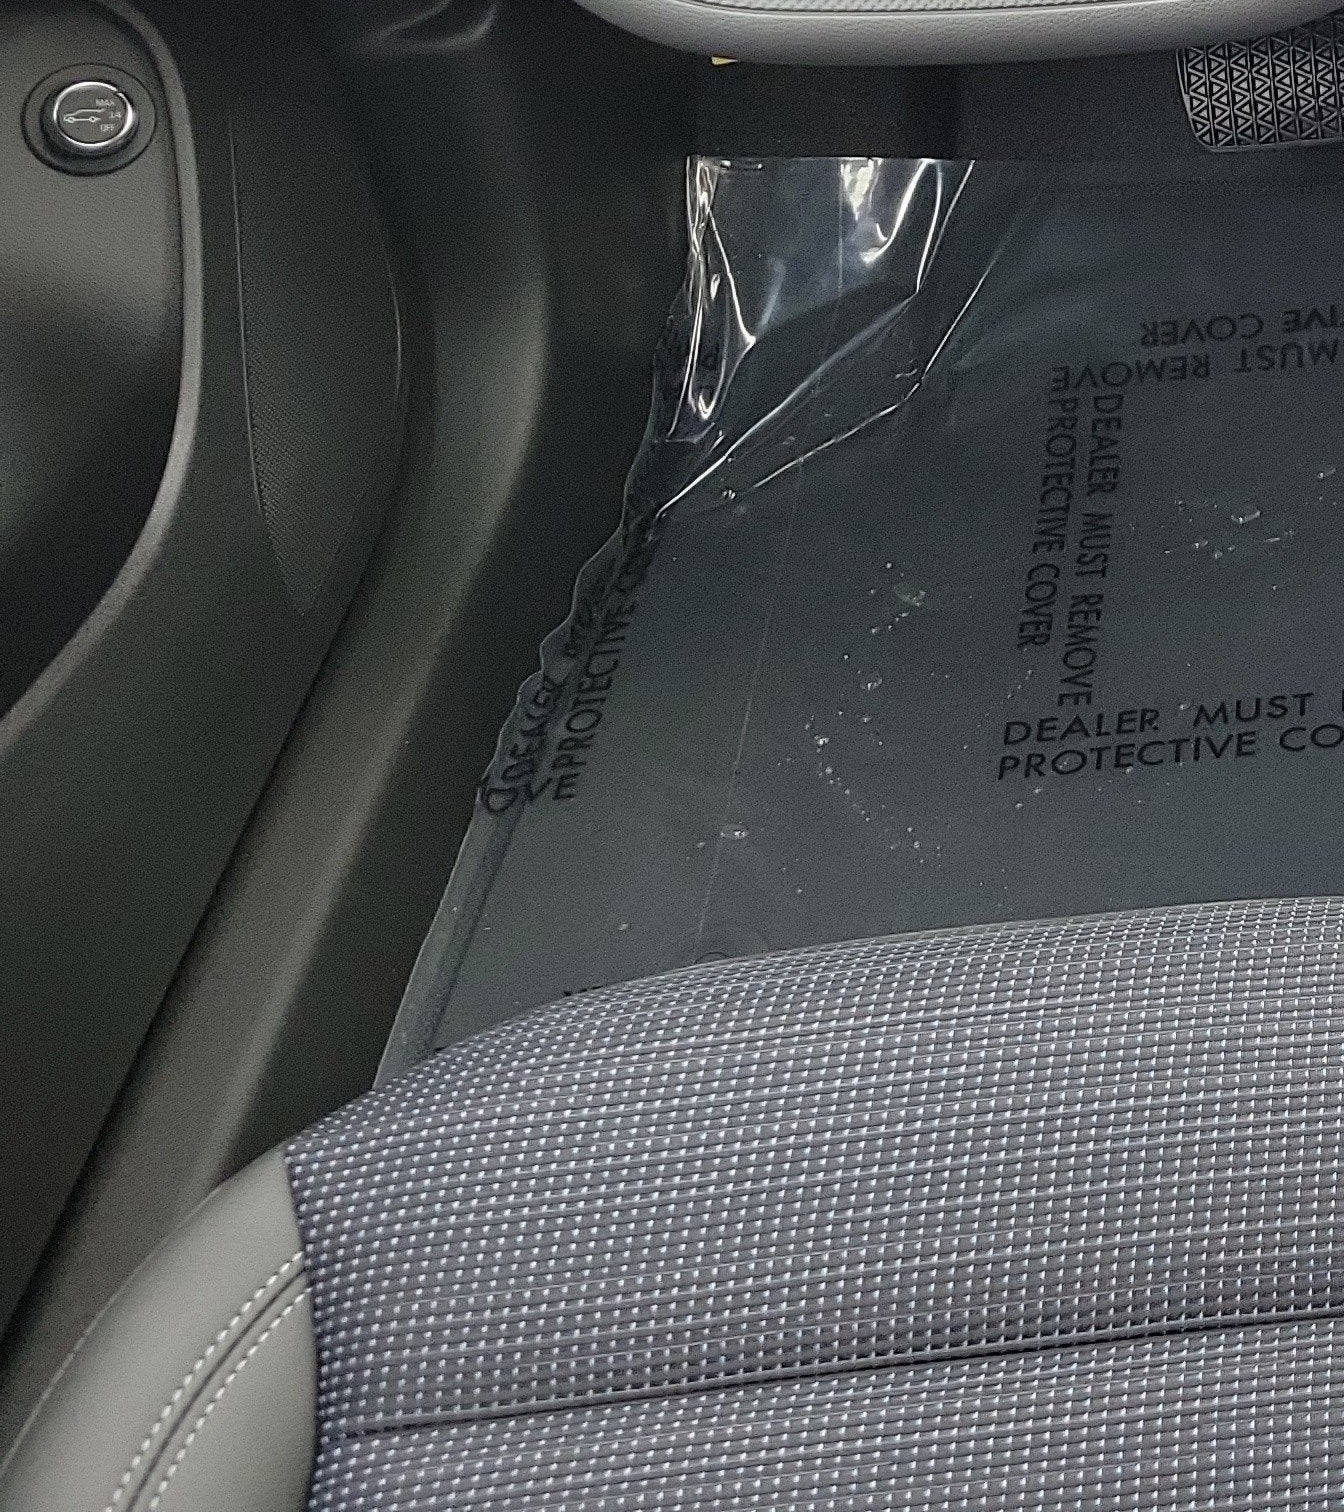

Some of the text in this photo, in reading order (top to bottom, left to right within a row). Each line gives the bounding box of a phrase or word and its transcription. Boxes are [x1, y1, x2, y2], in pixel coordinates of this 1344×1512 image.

[1140, 314, 1265, 346] COVER
[1234, 338, 1340, 373] MUST
[1049, 353, 1212, 392] REMOVE
[1016, 399, 1079, 649] PROTECTIVE COVER
[1056, 393, 1124, 706] DEALER MUST REMOVE
[555, 600, 638, 773] PROTECTIVE
[1003, 707, 1160, 746] DEALER
[1192, 692, 1315, 727] MUST
[997, 732, 1257, 780] PROTECTIVE
